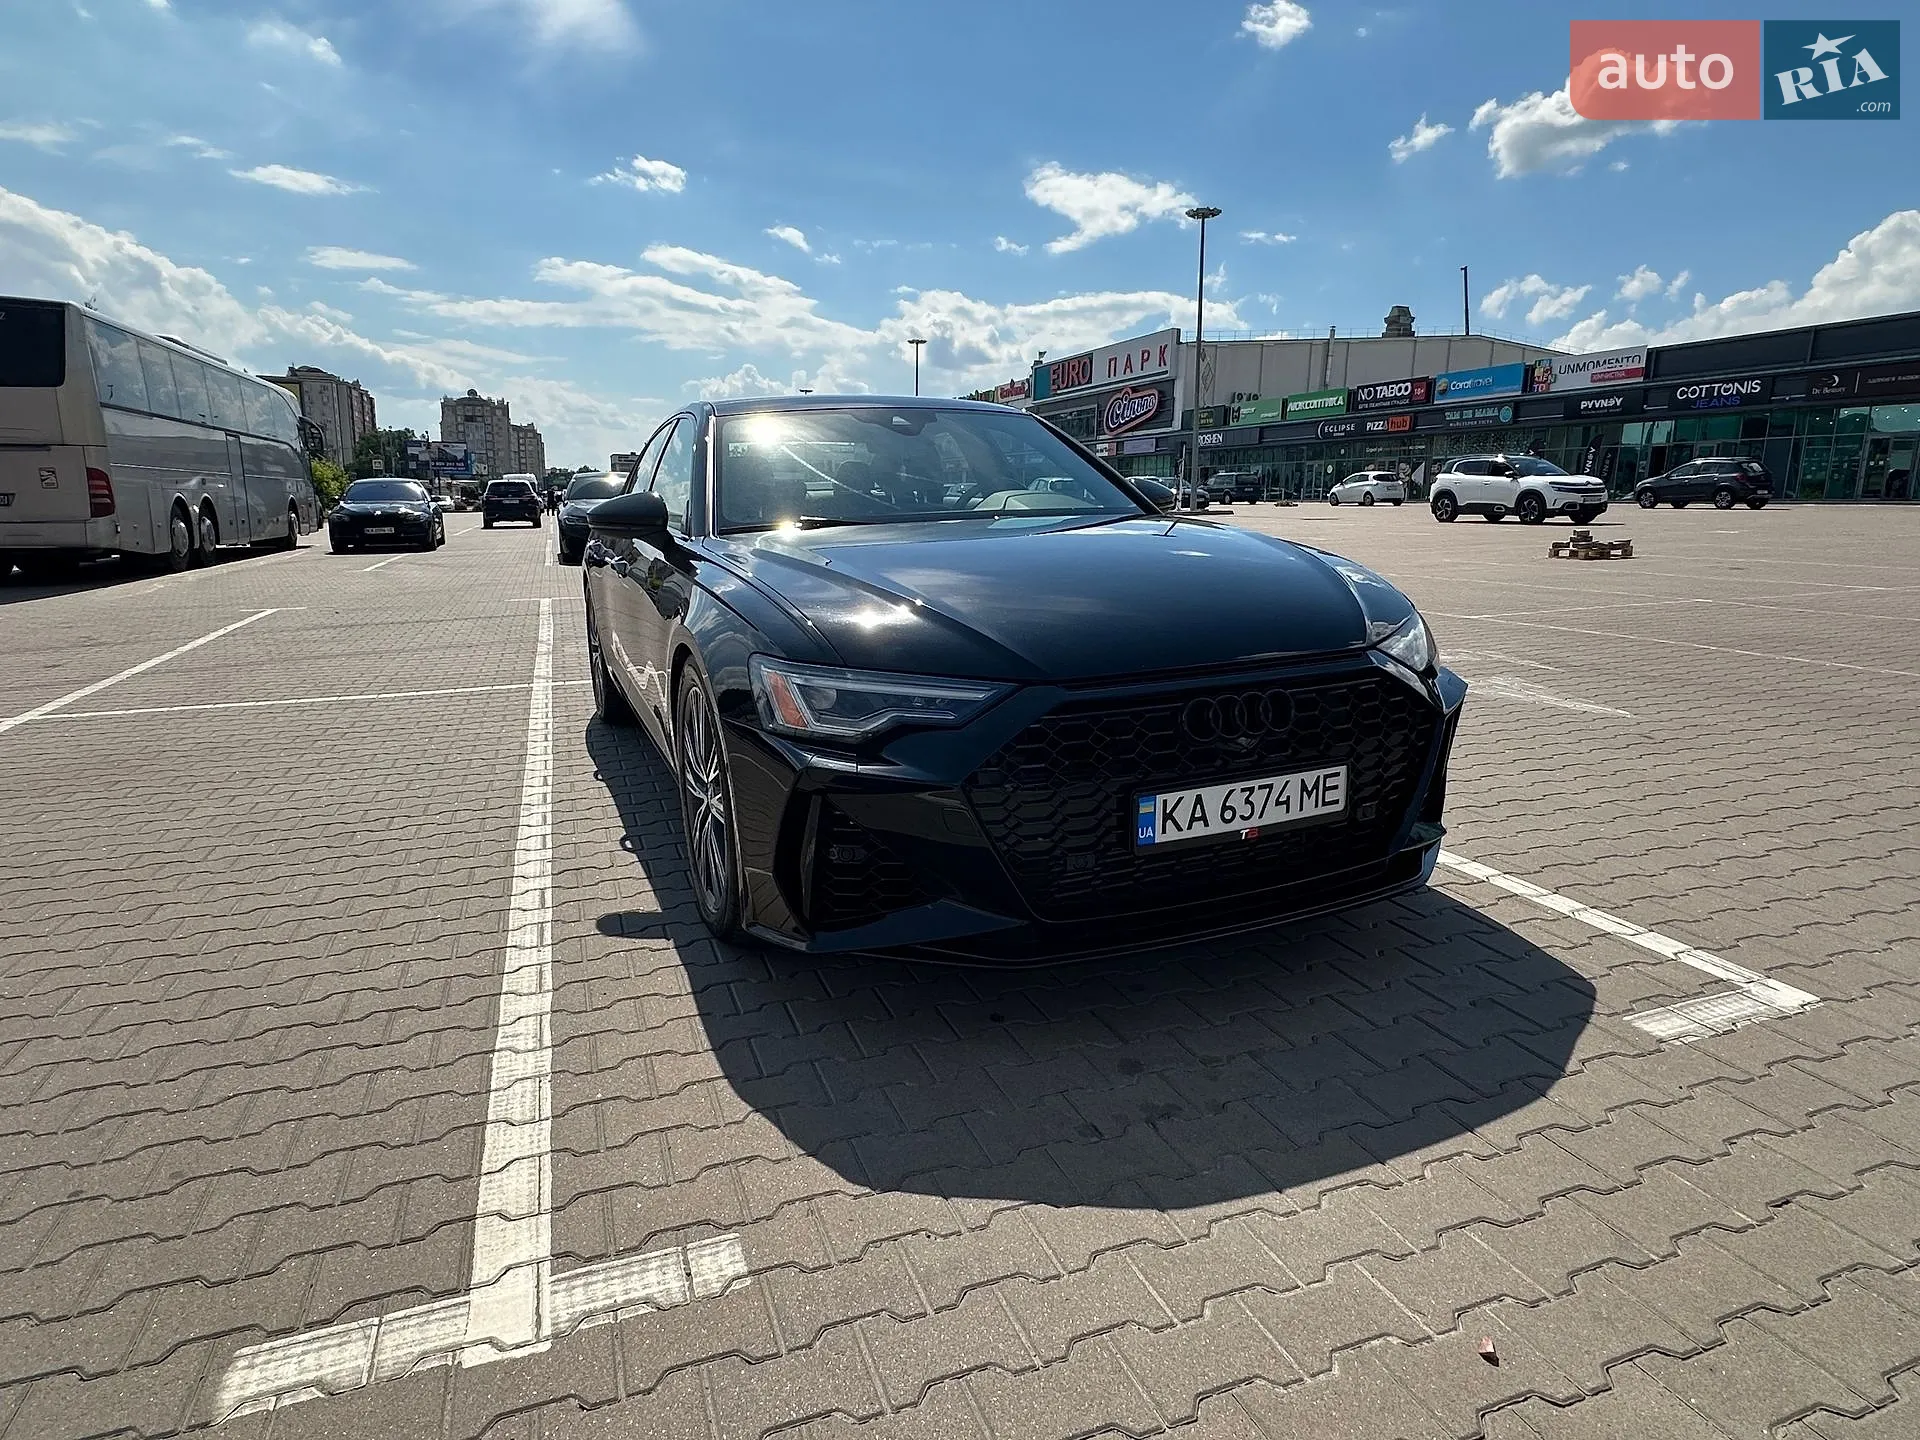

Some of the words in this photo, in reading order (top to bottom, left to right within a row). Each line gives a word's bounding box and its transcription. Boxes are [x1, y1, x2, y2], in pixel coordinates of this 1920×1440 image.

[1107, 344, 1168, 378] ПАРК
[1558, 354, 1641, 375] UNMOMENTO
[1050, 355, 1091, 392] EURO
[1358, 388, 1374, 401] NO
[1376, 382, 1412, 398] TABOO
[1676, 379, 1762, 400] COTTONIS
[1108, 391, 1157, 428] Сільпо
[1691, 396, 1741, 409] JEANS
[1325, 423, 1356, 433] ECLIPSE
[1391, 416, 1408, 429] hub
[1161, 793, 1210, 836] KA
[1219, 779, 1291, 825] 6374
[1298, 771, 1342, 812] ME
[1138, 827, 1154, 839] UA
